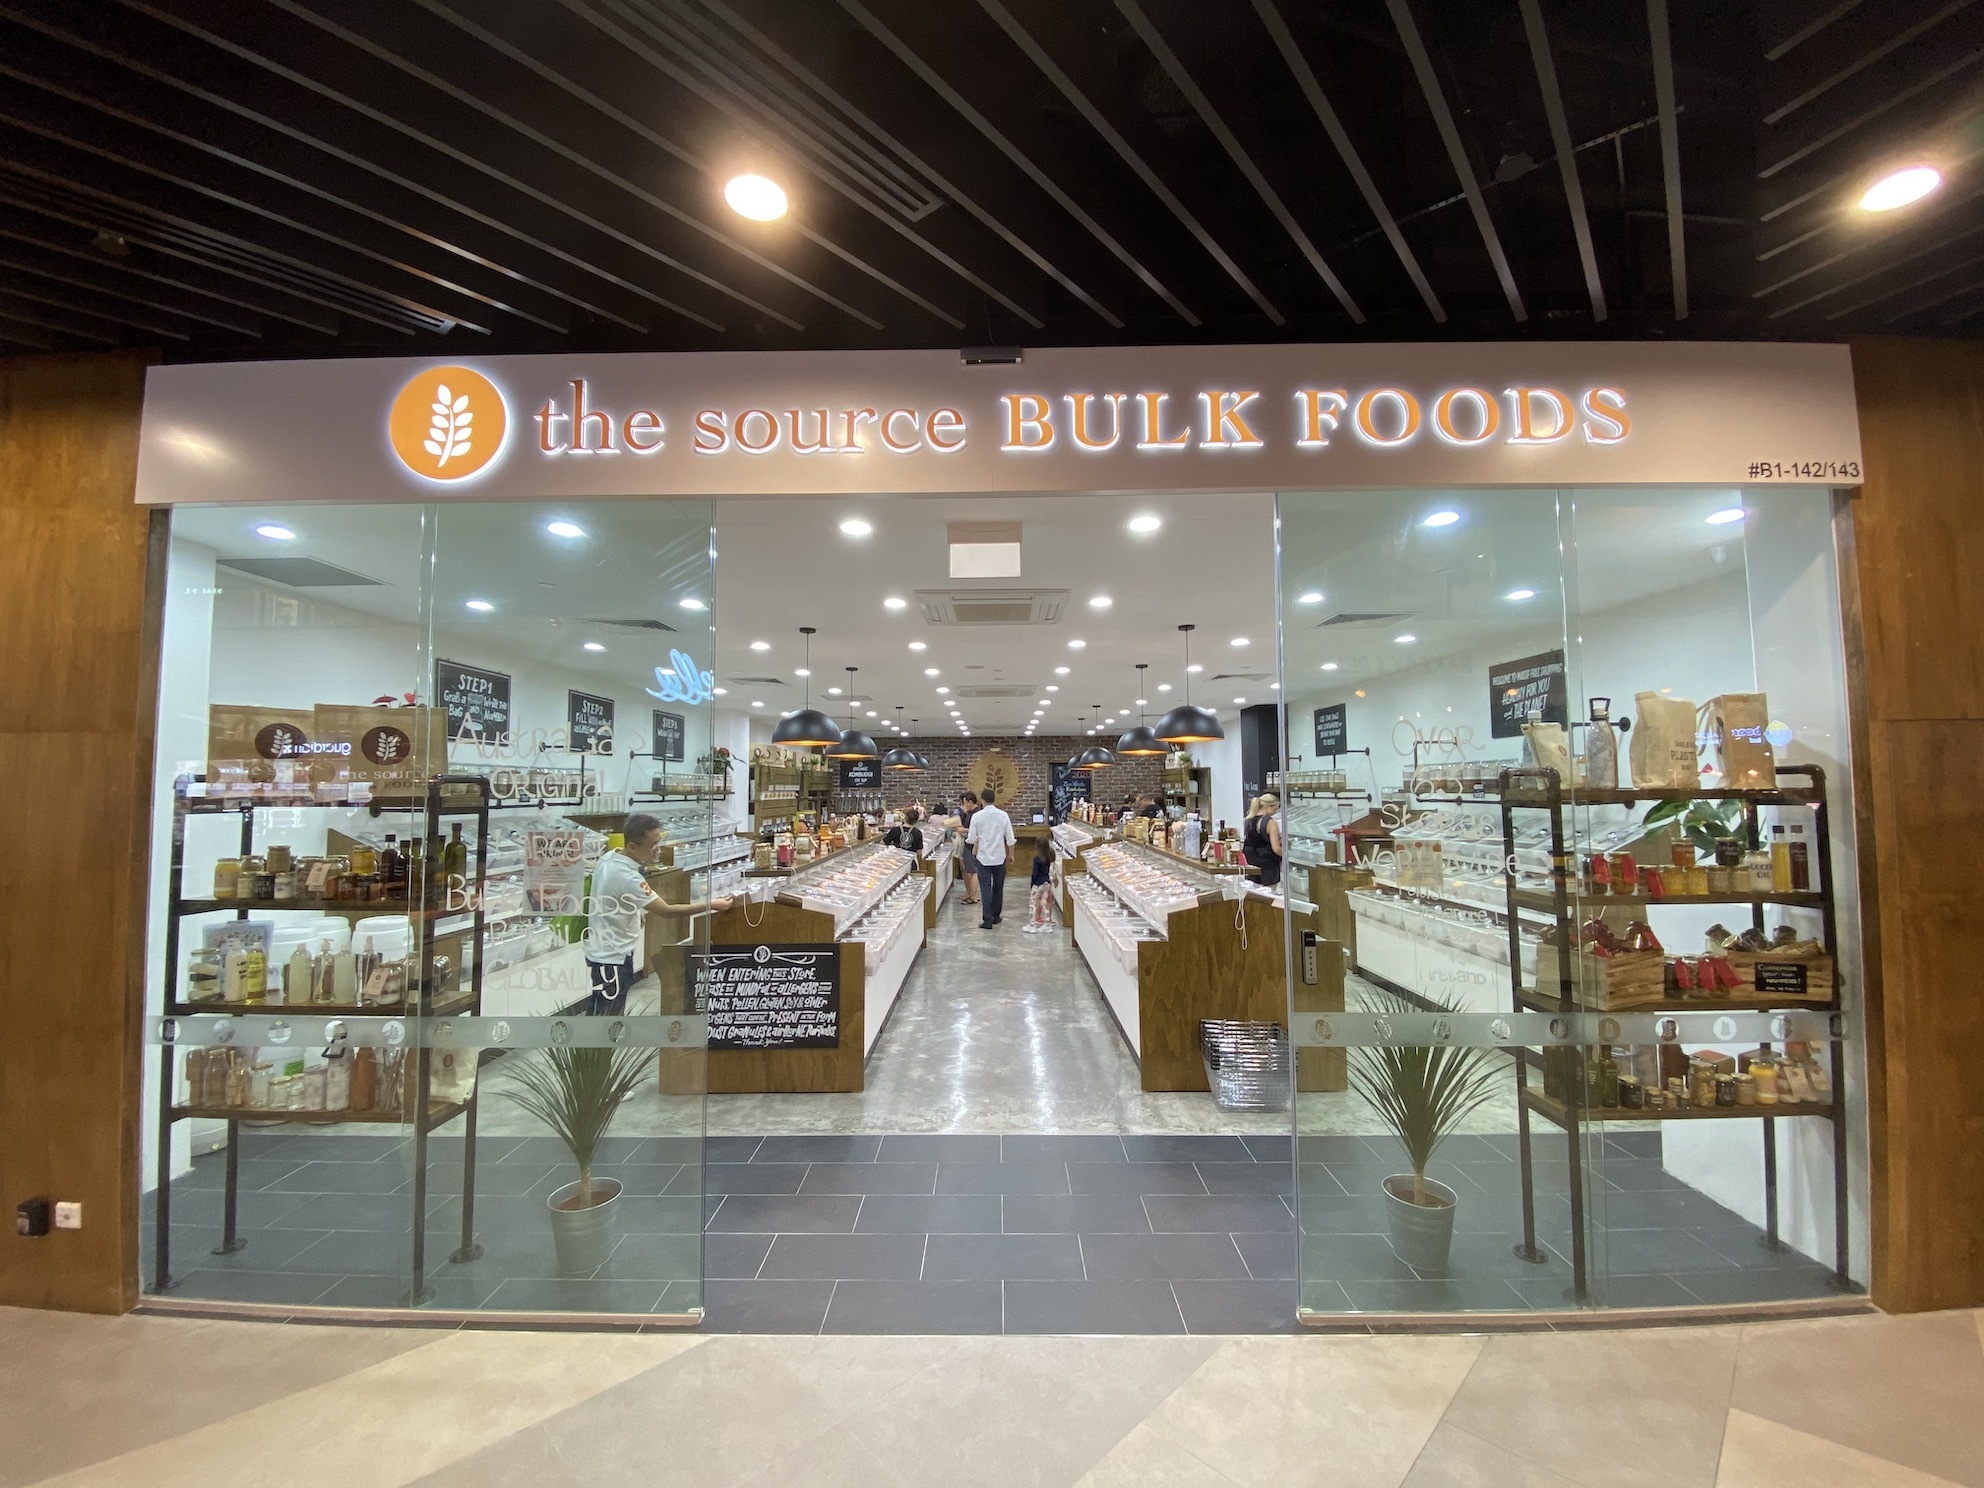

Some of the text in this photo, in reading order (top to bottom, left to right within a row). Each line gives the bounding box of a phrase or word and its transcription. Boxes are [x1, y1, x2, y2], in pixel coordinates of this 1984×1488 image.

[533, 379, 1633, 456] the source BULK FOODS
[1748, 462, 1860, 478] #B1-142/143
[1538, 676, 1551, 693] YOU
[696, 967, 727, 982] WHEN
